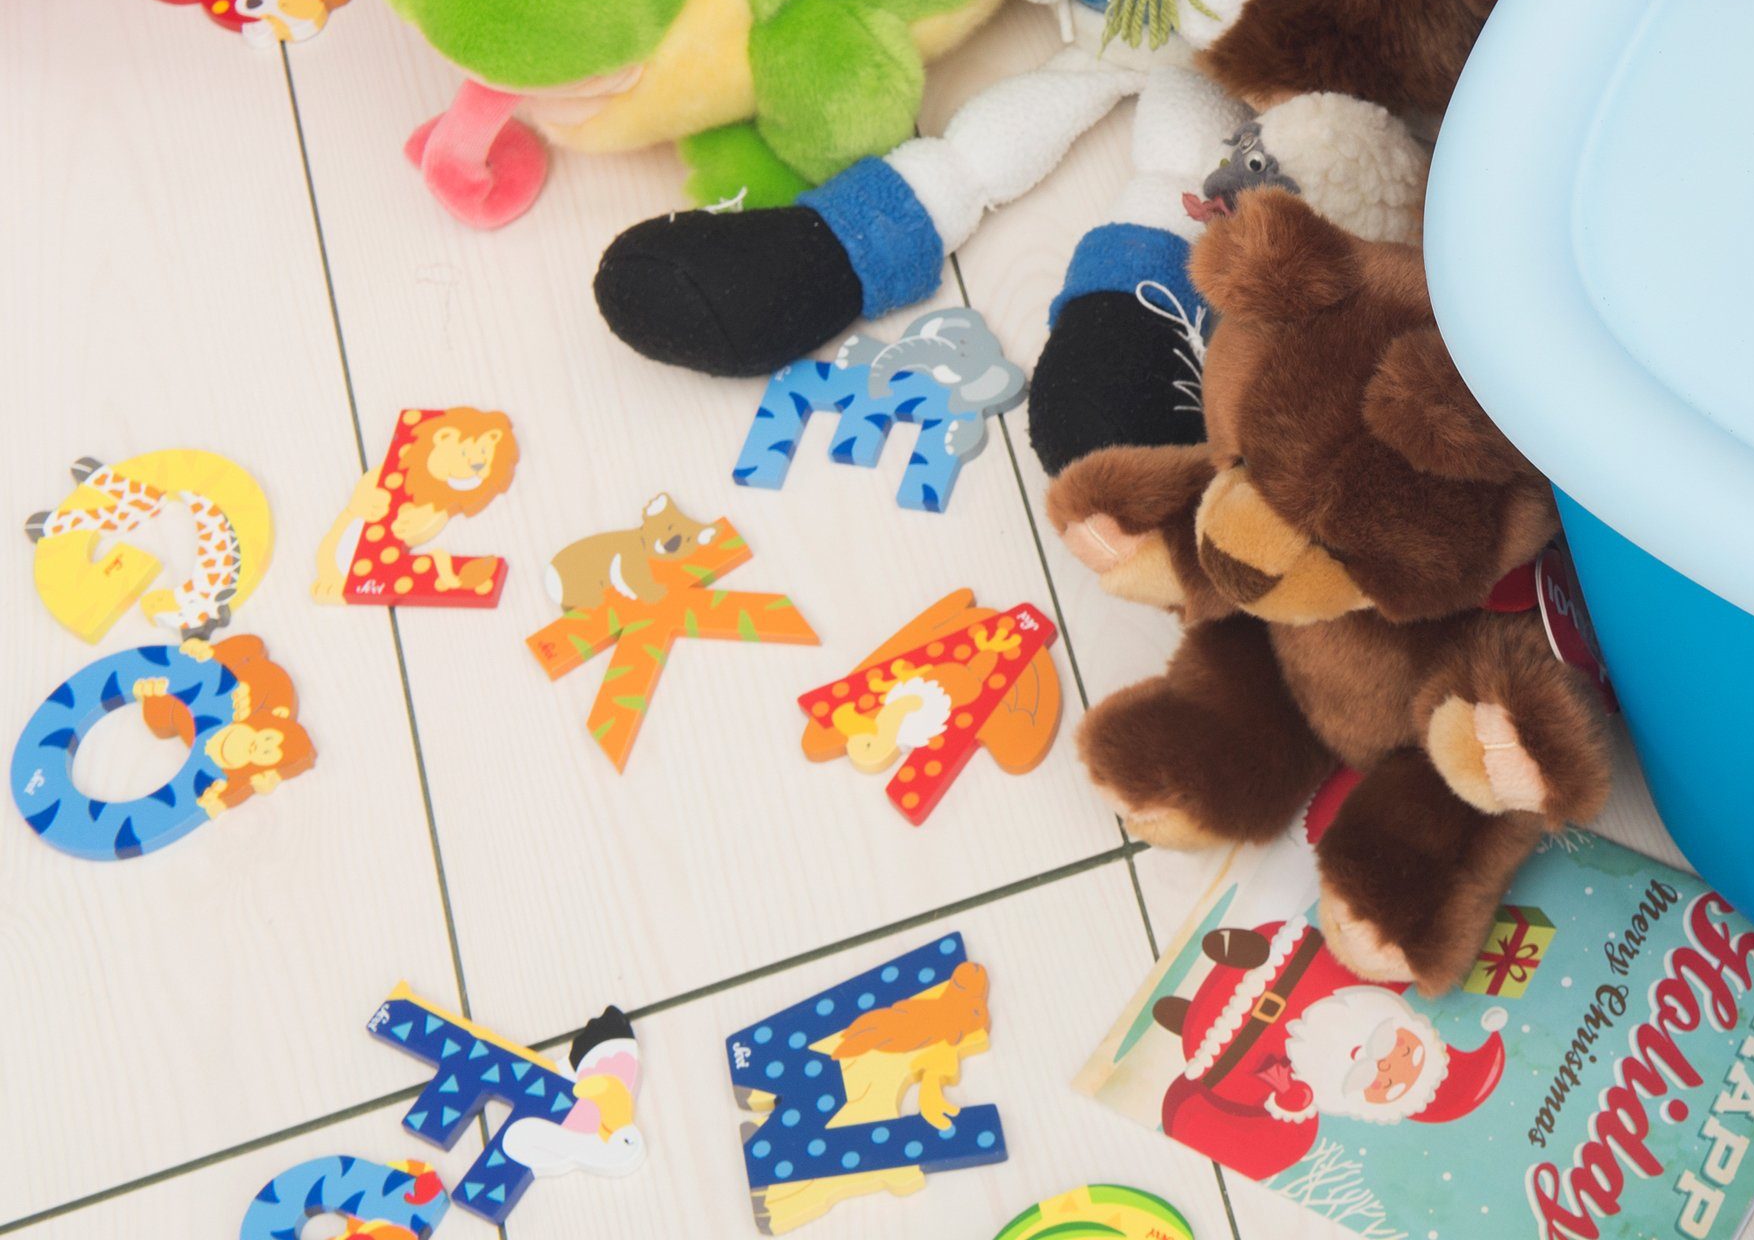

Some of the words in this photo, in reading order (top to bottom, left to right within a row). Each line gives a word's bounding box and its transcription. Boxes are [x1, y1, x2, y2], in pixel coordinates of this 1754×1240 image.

[342, 408, 509, 609] L
[525, 515, 823, 777] K
[1603, 878, 1679, 977] Merry
[1527, 983, 1629, 1149] Christmas
